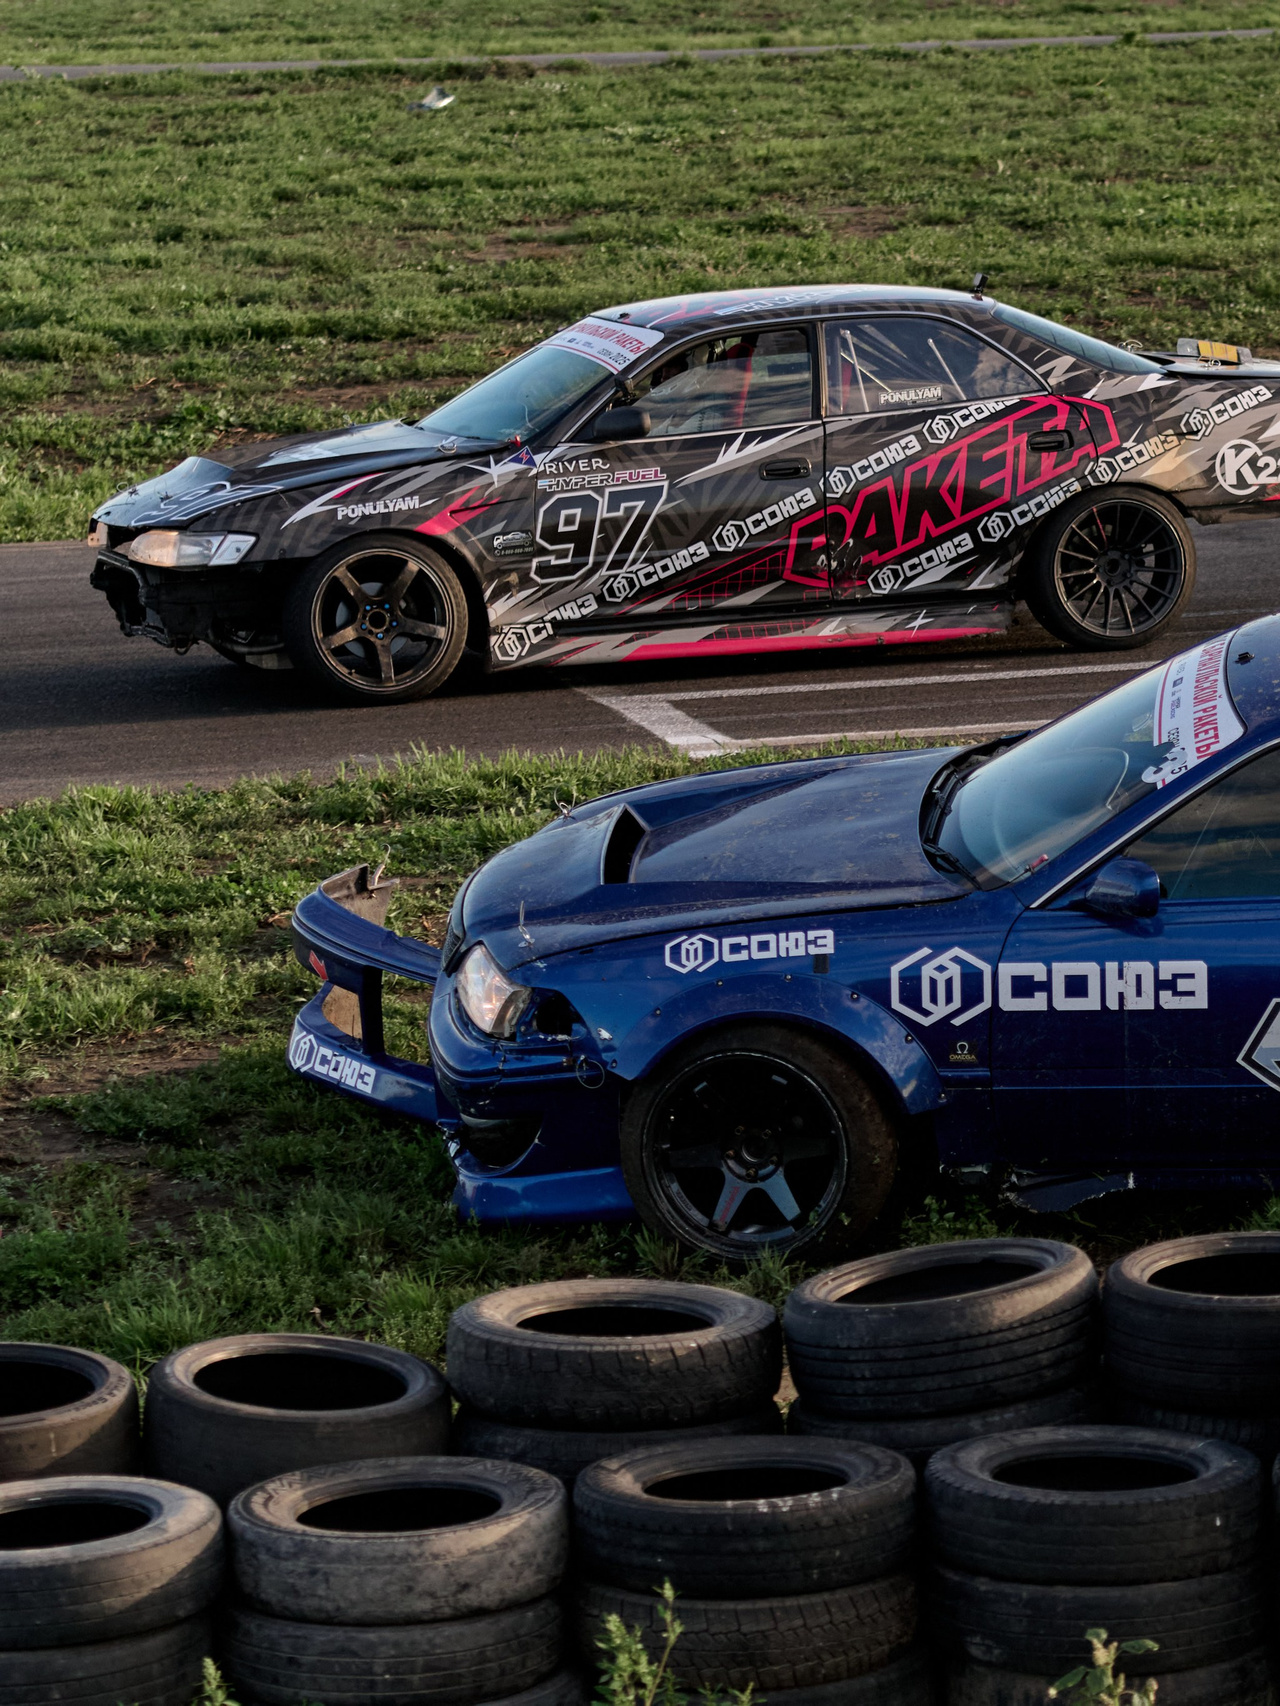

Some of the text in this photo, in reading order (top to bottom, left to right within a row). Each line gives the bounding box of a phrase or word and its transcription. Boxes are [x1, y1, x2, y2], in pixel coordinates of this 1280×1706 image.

[609, 333, 650, 355] РАКЕТЫ
[879, 386, 942, 404] PONULYAM
[953, 399, 1020, 428] СОЮ
[1208, 385, 1273, 425] СОЮЗ
[545, 458, 610, 475] RIVER
[851, 434, 922, 481] СОЮЗ
[1116, 431, 1181, 472] СОЮЗ
[337, 496, 419, 520] PONULYAM
[747, 487, 816, 536] СОЮЗ
[1011, 477, 1082, 526] СОЮЗ
[531, 480, 669, 584] 97
[903, 532, 974, 577] СОЮЗ
[637, 541, 710, 587] СОЮЗ
[1193, 704, 1220, 760] РАКЕТЫ
[721, 929, 835, 962] СОЮЗ
[998, 960, 1208, 1012] СОЮЗ
[314, 1046, 376, 1094] СОЮЗ
